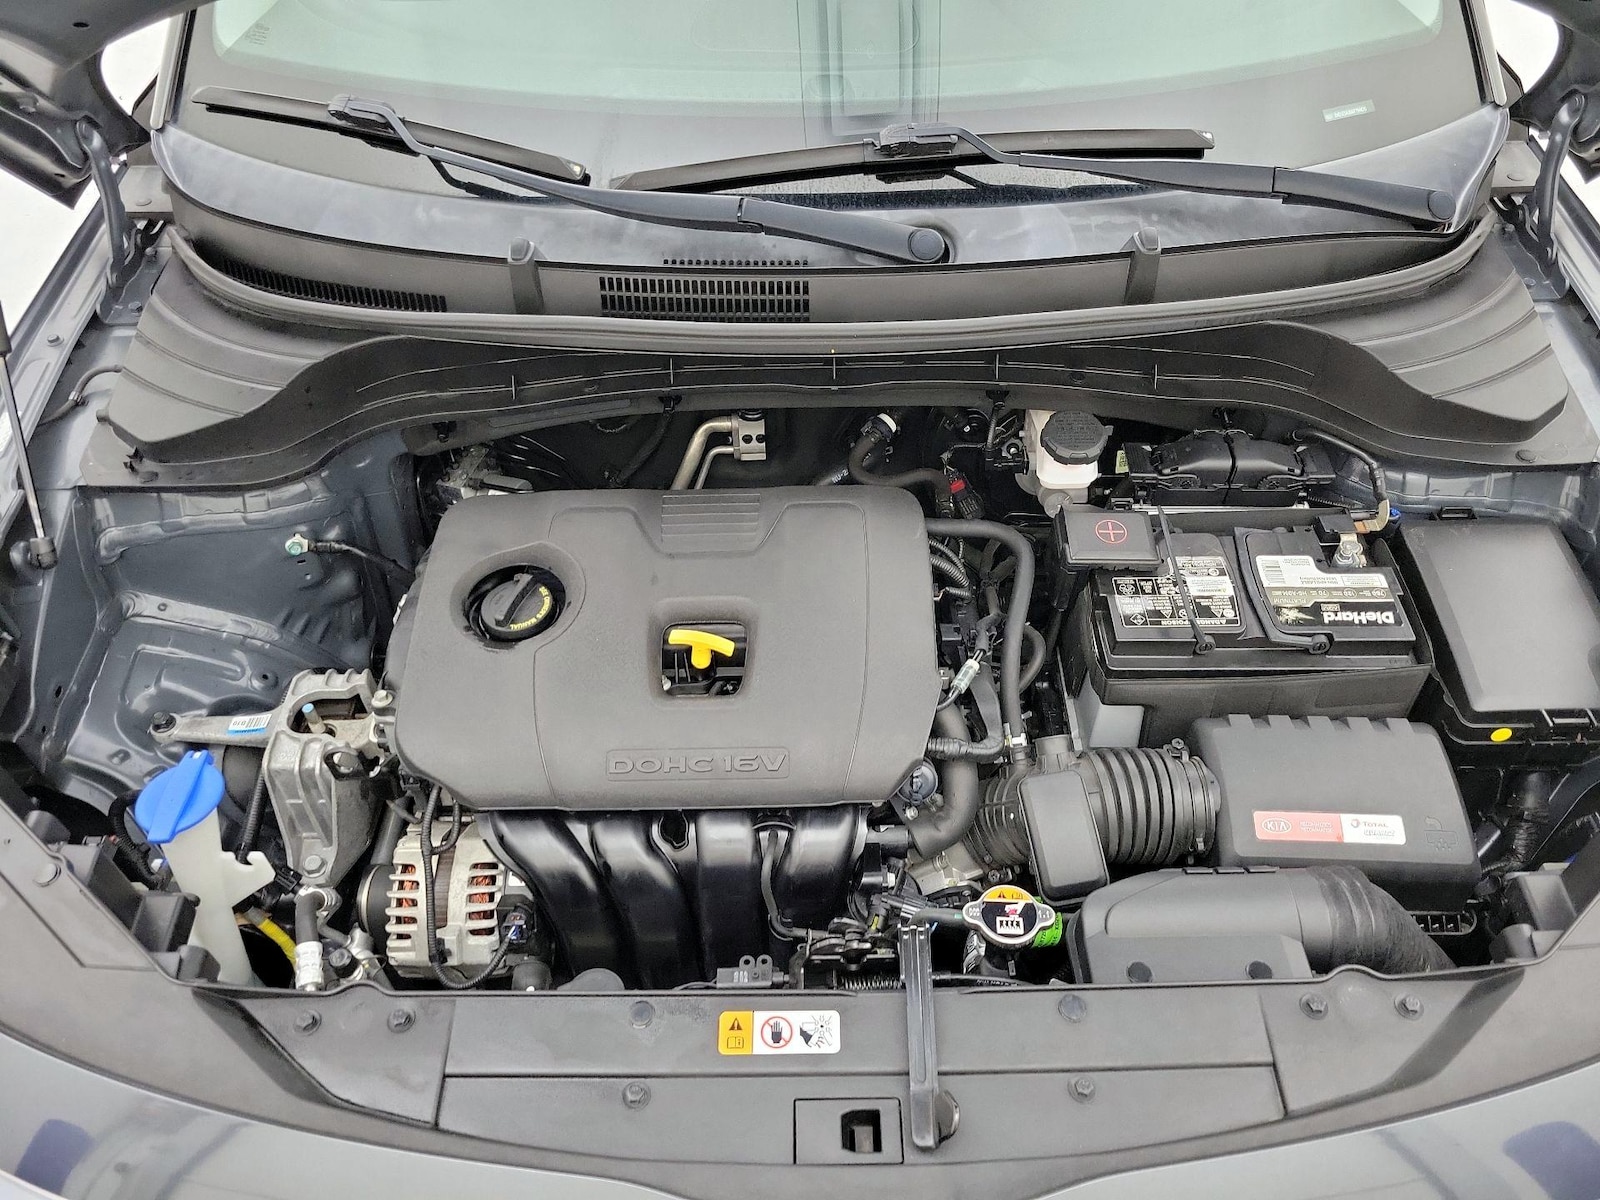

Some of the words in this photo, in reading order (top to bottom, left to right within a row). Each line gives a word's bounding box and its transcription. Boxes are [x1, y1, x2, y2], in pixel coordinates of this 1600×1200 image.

[1272, 597, 1307, 605] PLATINUM
[509, 617, 538, 631] MANUAL
[1322, 610, 1396, 625] DieHard
[608, 754, 714, 774] DOHC
[722, 753, 787, 773] 16V
[1264, 819, 1289, 832] KIA
